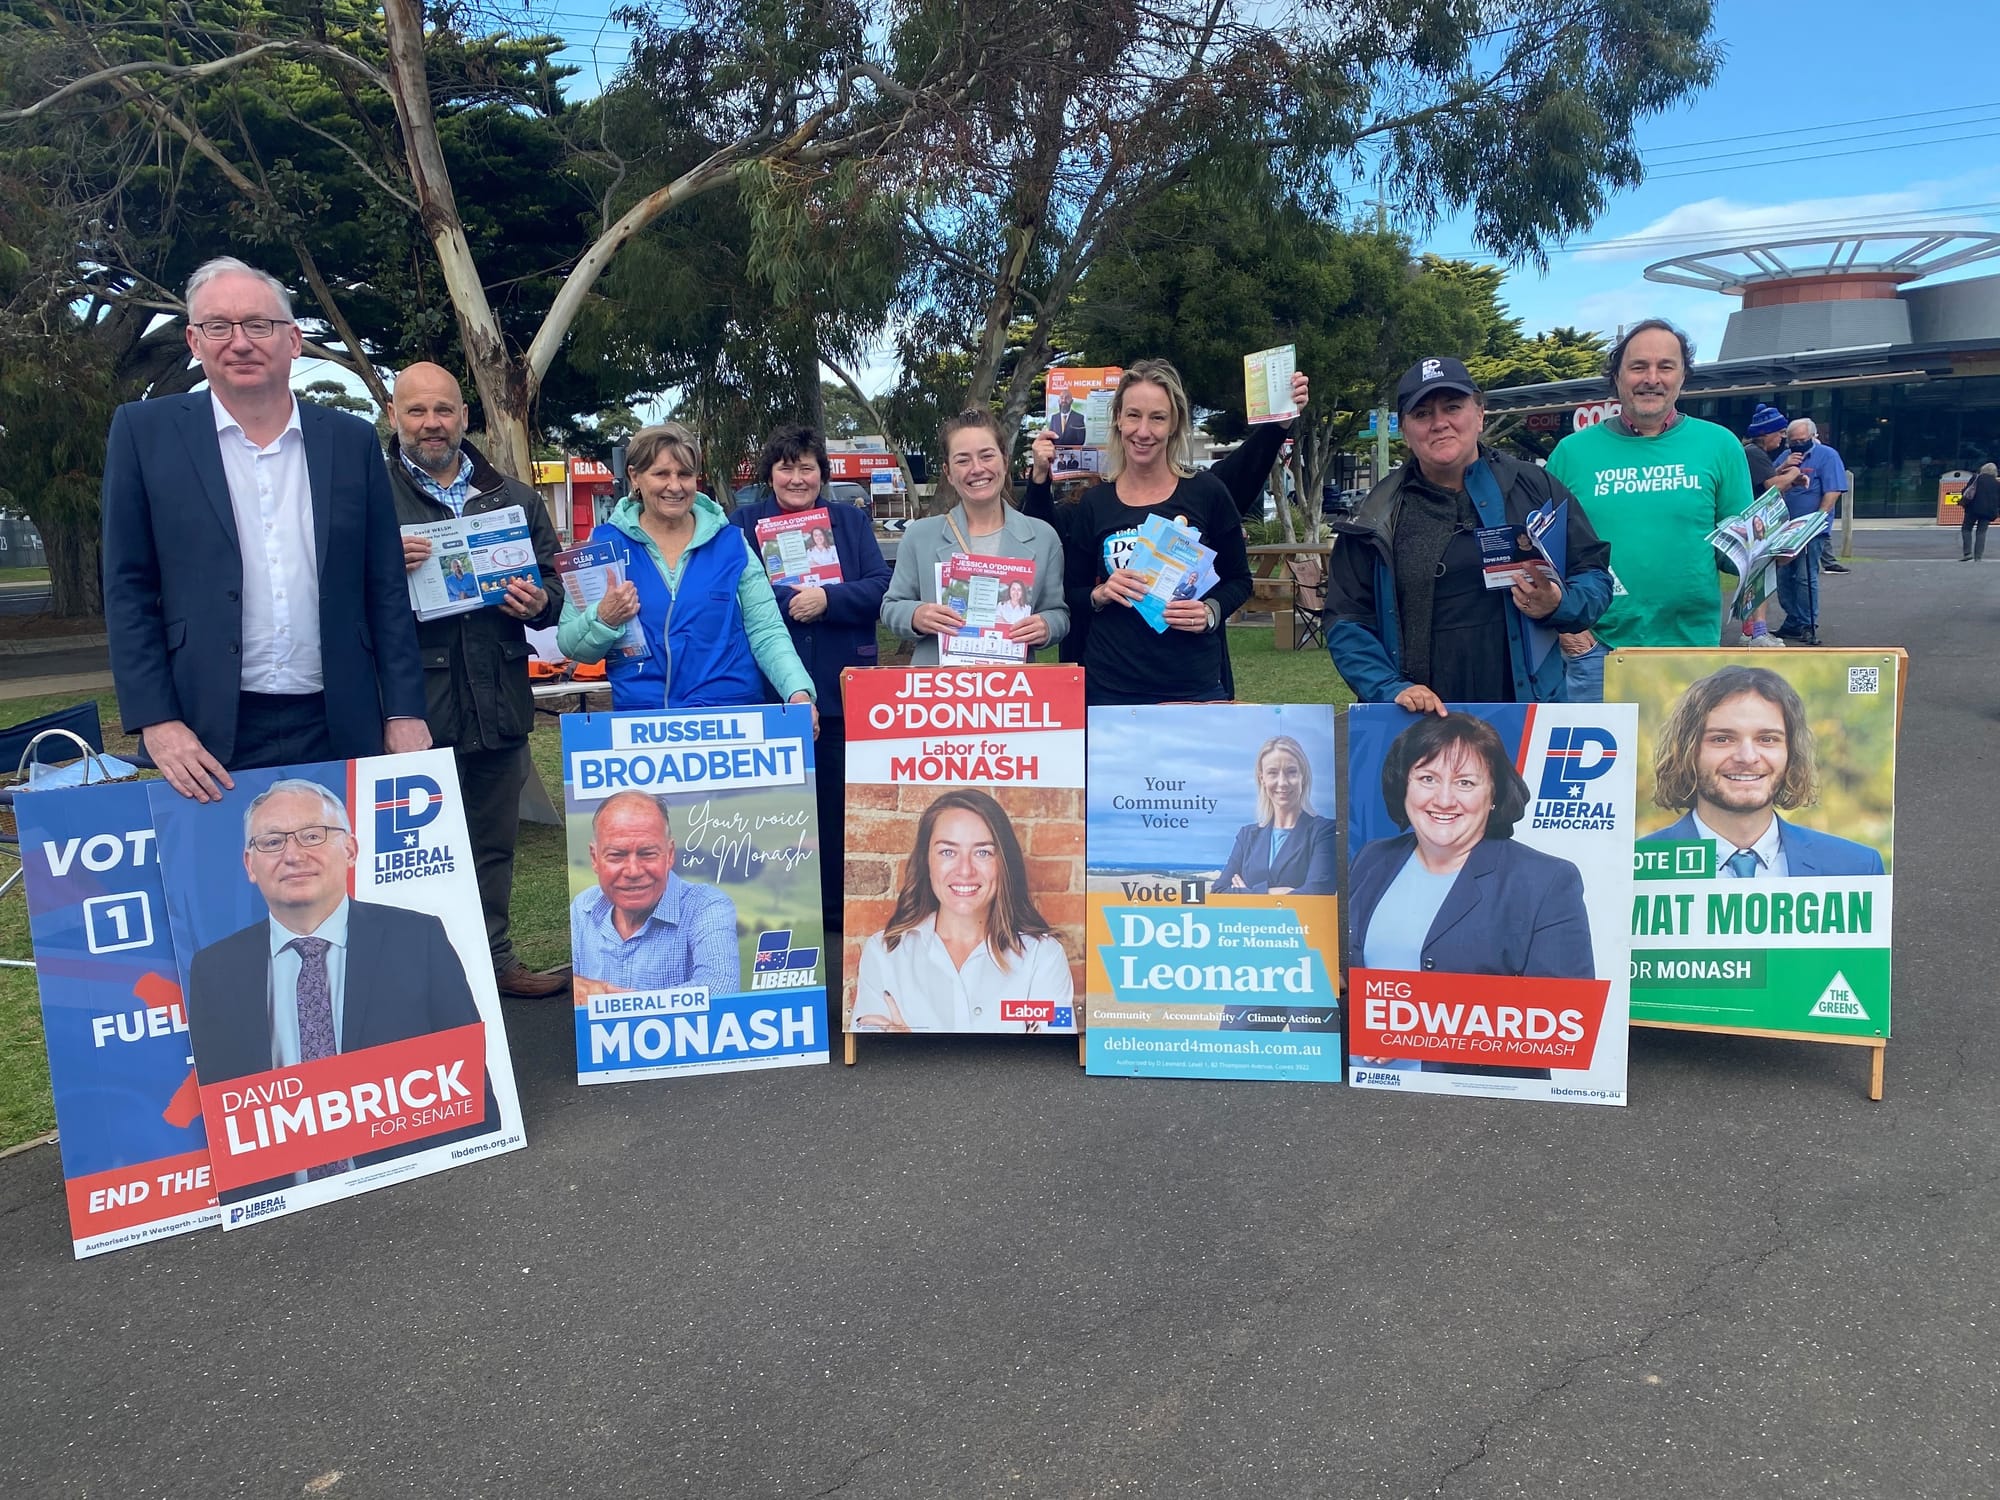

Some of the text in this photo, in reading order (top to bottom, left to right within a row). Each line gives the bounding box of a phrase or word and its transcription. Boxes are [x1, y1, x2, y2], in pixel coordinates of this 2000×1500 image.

[574, 462, 596, 475] REAL
[1595, 464, 1685, 483] YOUR VOTE
[1594, 475, 1702, 496] IS POWERFUL
[763, 519, 789, 529] JESSICA
[789, 513, 827, 524] O'DONNELL
[1116, 528, 1138, 538] Vote
[573, 553, 594, 565] CLEAR
[957, 560, 1033, 573] JESSICA O'DONNELL
[1483, 555, 1511, 563] EDWARDS
[895, 671, 1034, 698] JESSICA
[869, 702, 1062, 730] O'DONNELL
[630, 719, 746, 744] RUSSELL
[923, 740, 1007, 756] Labor for
[580, 746, 797, 789] BROADBENT
[890, 756, 1038, 781] MONASH
[1144, 777, 1186, 792] Your
[1112, 795, 1218, 814] Community
[1534, 801, 1616, 818] LIBERAL
[685, 800, 809, 852] Your voice
[1141, 814, 1189, 829] Voice
[1532, 819, 1615, 830] DEMOCRATS
[43, 829, 160, 877] VOT
[375, 845, 454, 873] LIBERAL
[682, 829, 812, 883] in Monash
[1633, 852, 1695, 871] OTE 1
[375, 862, 455, 885] DEMOCRATS
[1121, 882, 1200, 903] Vote 1
[106, 905, 129, 940] 1
[1707, 891, 1873, 935] MORGAN
[1120, 912, 1211, 949] Deb
[1218, 922, 1310, 936] Independent
[1218, 936, 1299, 948] for Monash
[751, 969, 817, 990] LIBERAL
[1119, 956, 1314, 993] Leonard
[1657, 960, 1751, 979] MONASH
[1365, 980, 1412, 998] MEG
[1830, 989, 1849, 1001] THE
[594, 992, 705, 1014] LIBERAL FOR
[1005, 1004, 1050, 1018] Labor
[1818, 1001, 1859, 1015] GREENS
[92, 1003, 189, 1048] FUEL
[1093, 1010, 1322, 1024] Community Accountability Climate Action
[1365, 998, 1585, 1042] EDWARDS
[590, 1005, 815, 1064] MONASH
[1103, 1037, 1322, 1056] debleonard4monash.com.au
[1380, 1033, 1576, 1057] CANDIDATE FOR MONASH
[1367, 1079, 1401, 1087] DEMOCRATS
[1368, 1073, 1401, 1081] LIBERAL
[221, 1077, 303, 1113] DAVID
[1550, 1086, 1621, 1100] libdems.org.au
[224, 1059, 472, 1156] LIMBRICK
[370, 1098, 473, 1138] FOR SENATE
[451, 1135, 520, 1161] libdems.org.au
[89, 1165, 211, 1214] END THE
[245, 1195, 286, 1213] LIBERAL
[245, 1203, 286, 1220] DEMOCRATS
[85, 1233, 130, 1252] Authorised
[130, 1232, 141, 1241] by
[149, 1219, 191, 1236] Westgarth
